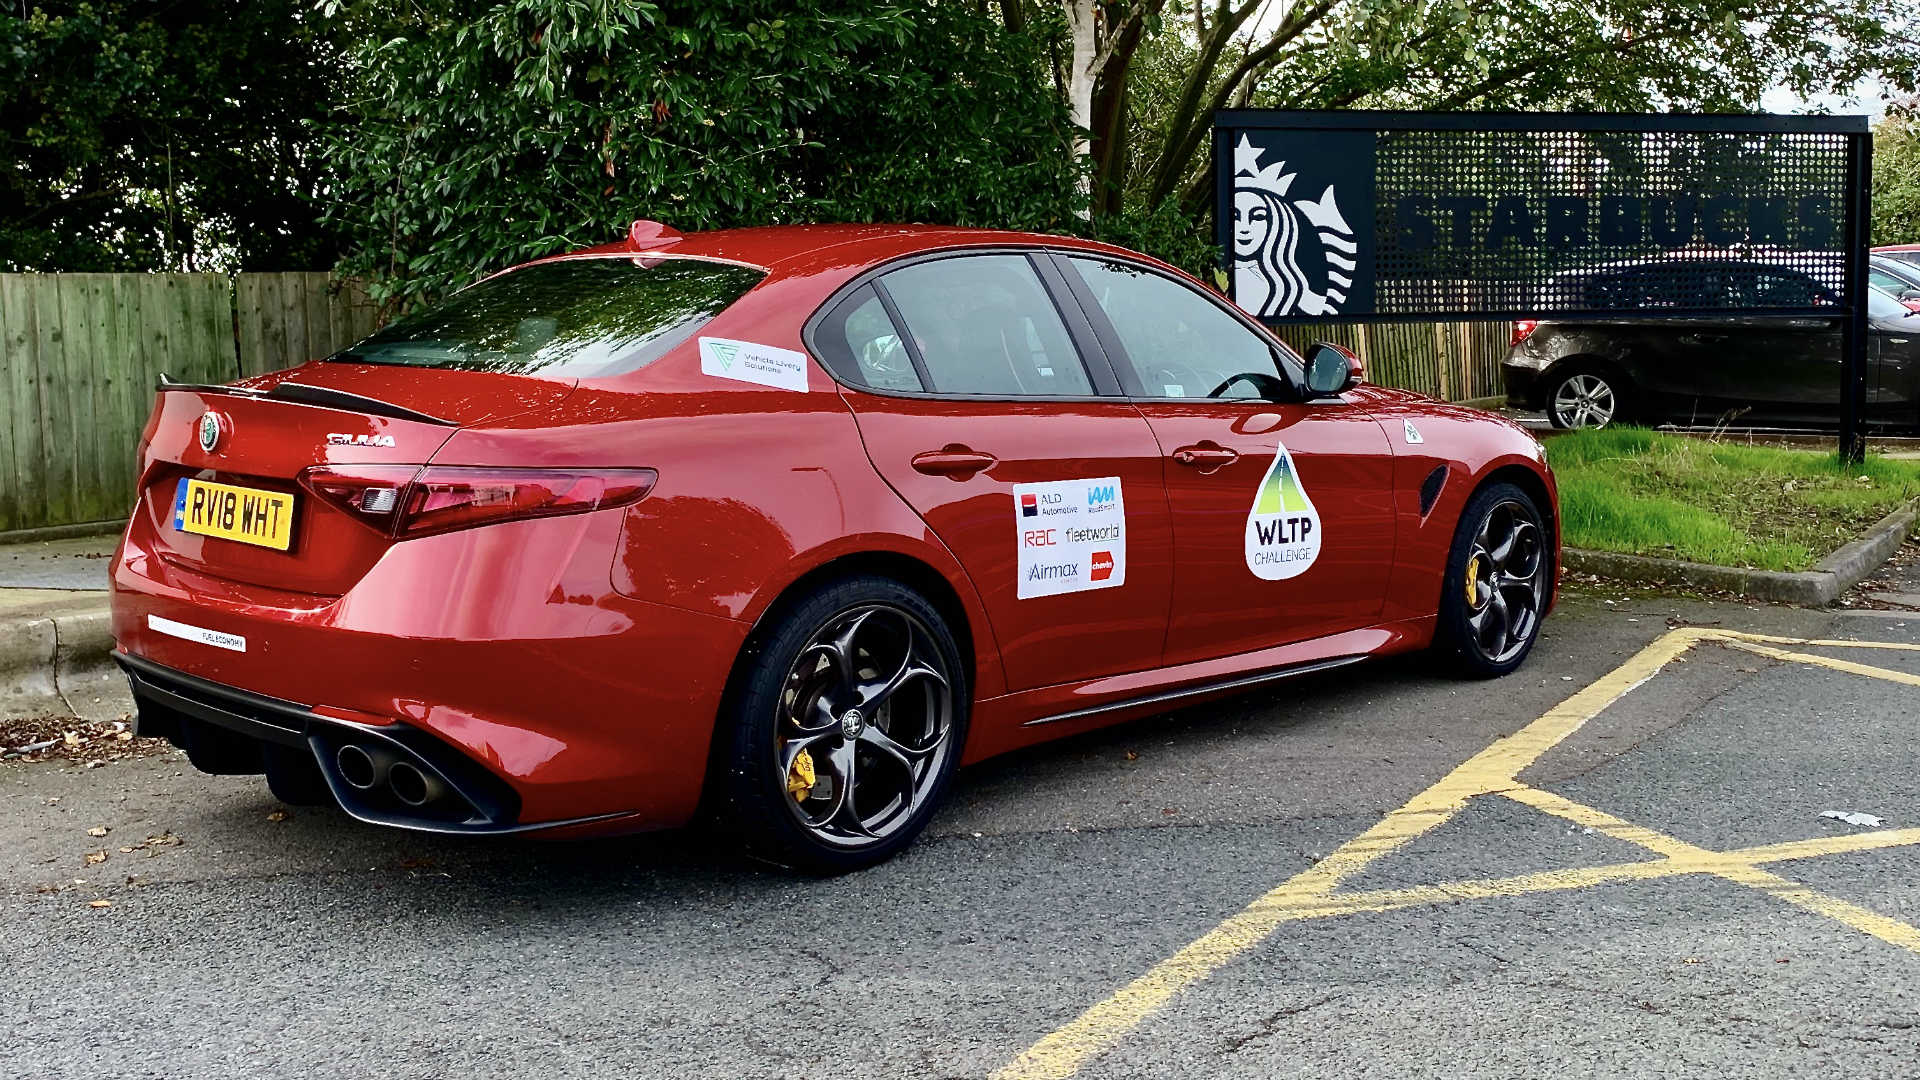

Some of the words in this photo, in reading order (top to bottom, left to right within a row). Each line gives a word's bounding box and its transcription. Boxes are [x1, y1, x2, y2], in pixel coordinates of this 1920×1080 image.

[1395, 194, 1833, 249] STARBUCKS
[1041, 493, 1062, 505] ALD
[191, 486, 237, 531] RV18
[241, 494, 284, 539] WHT
[1042, 506, 1078, 516] Automotive
[1065, 523, 1120, 543] fleetworld
[1254, 517, 1313, 546] WLTP
[1254, 547, 1312, 566] CHALLENGE
[1027, 562, 1079, 581] Airmax
[202, 631, 215, 643] FUEL
